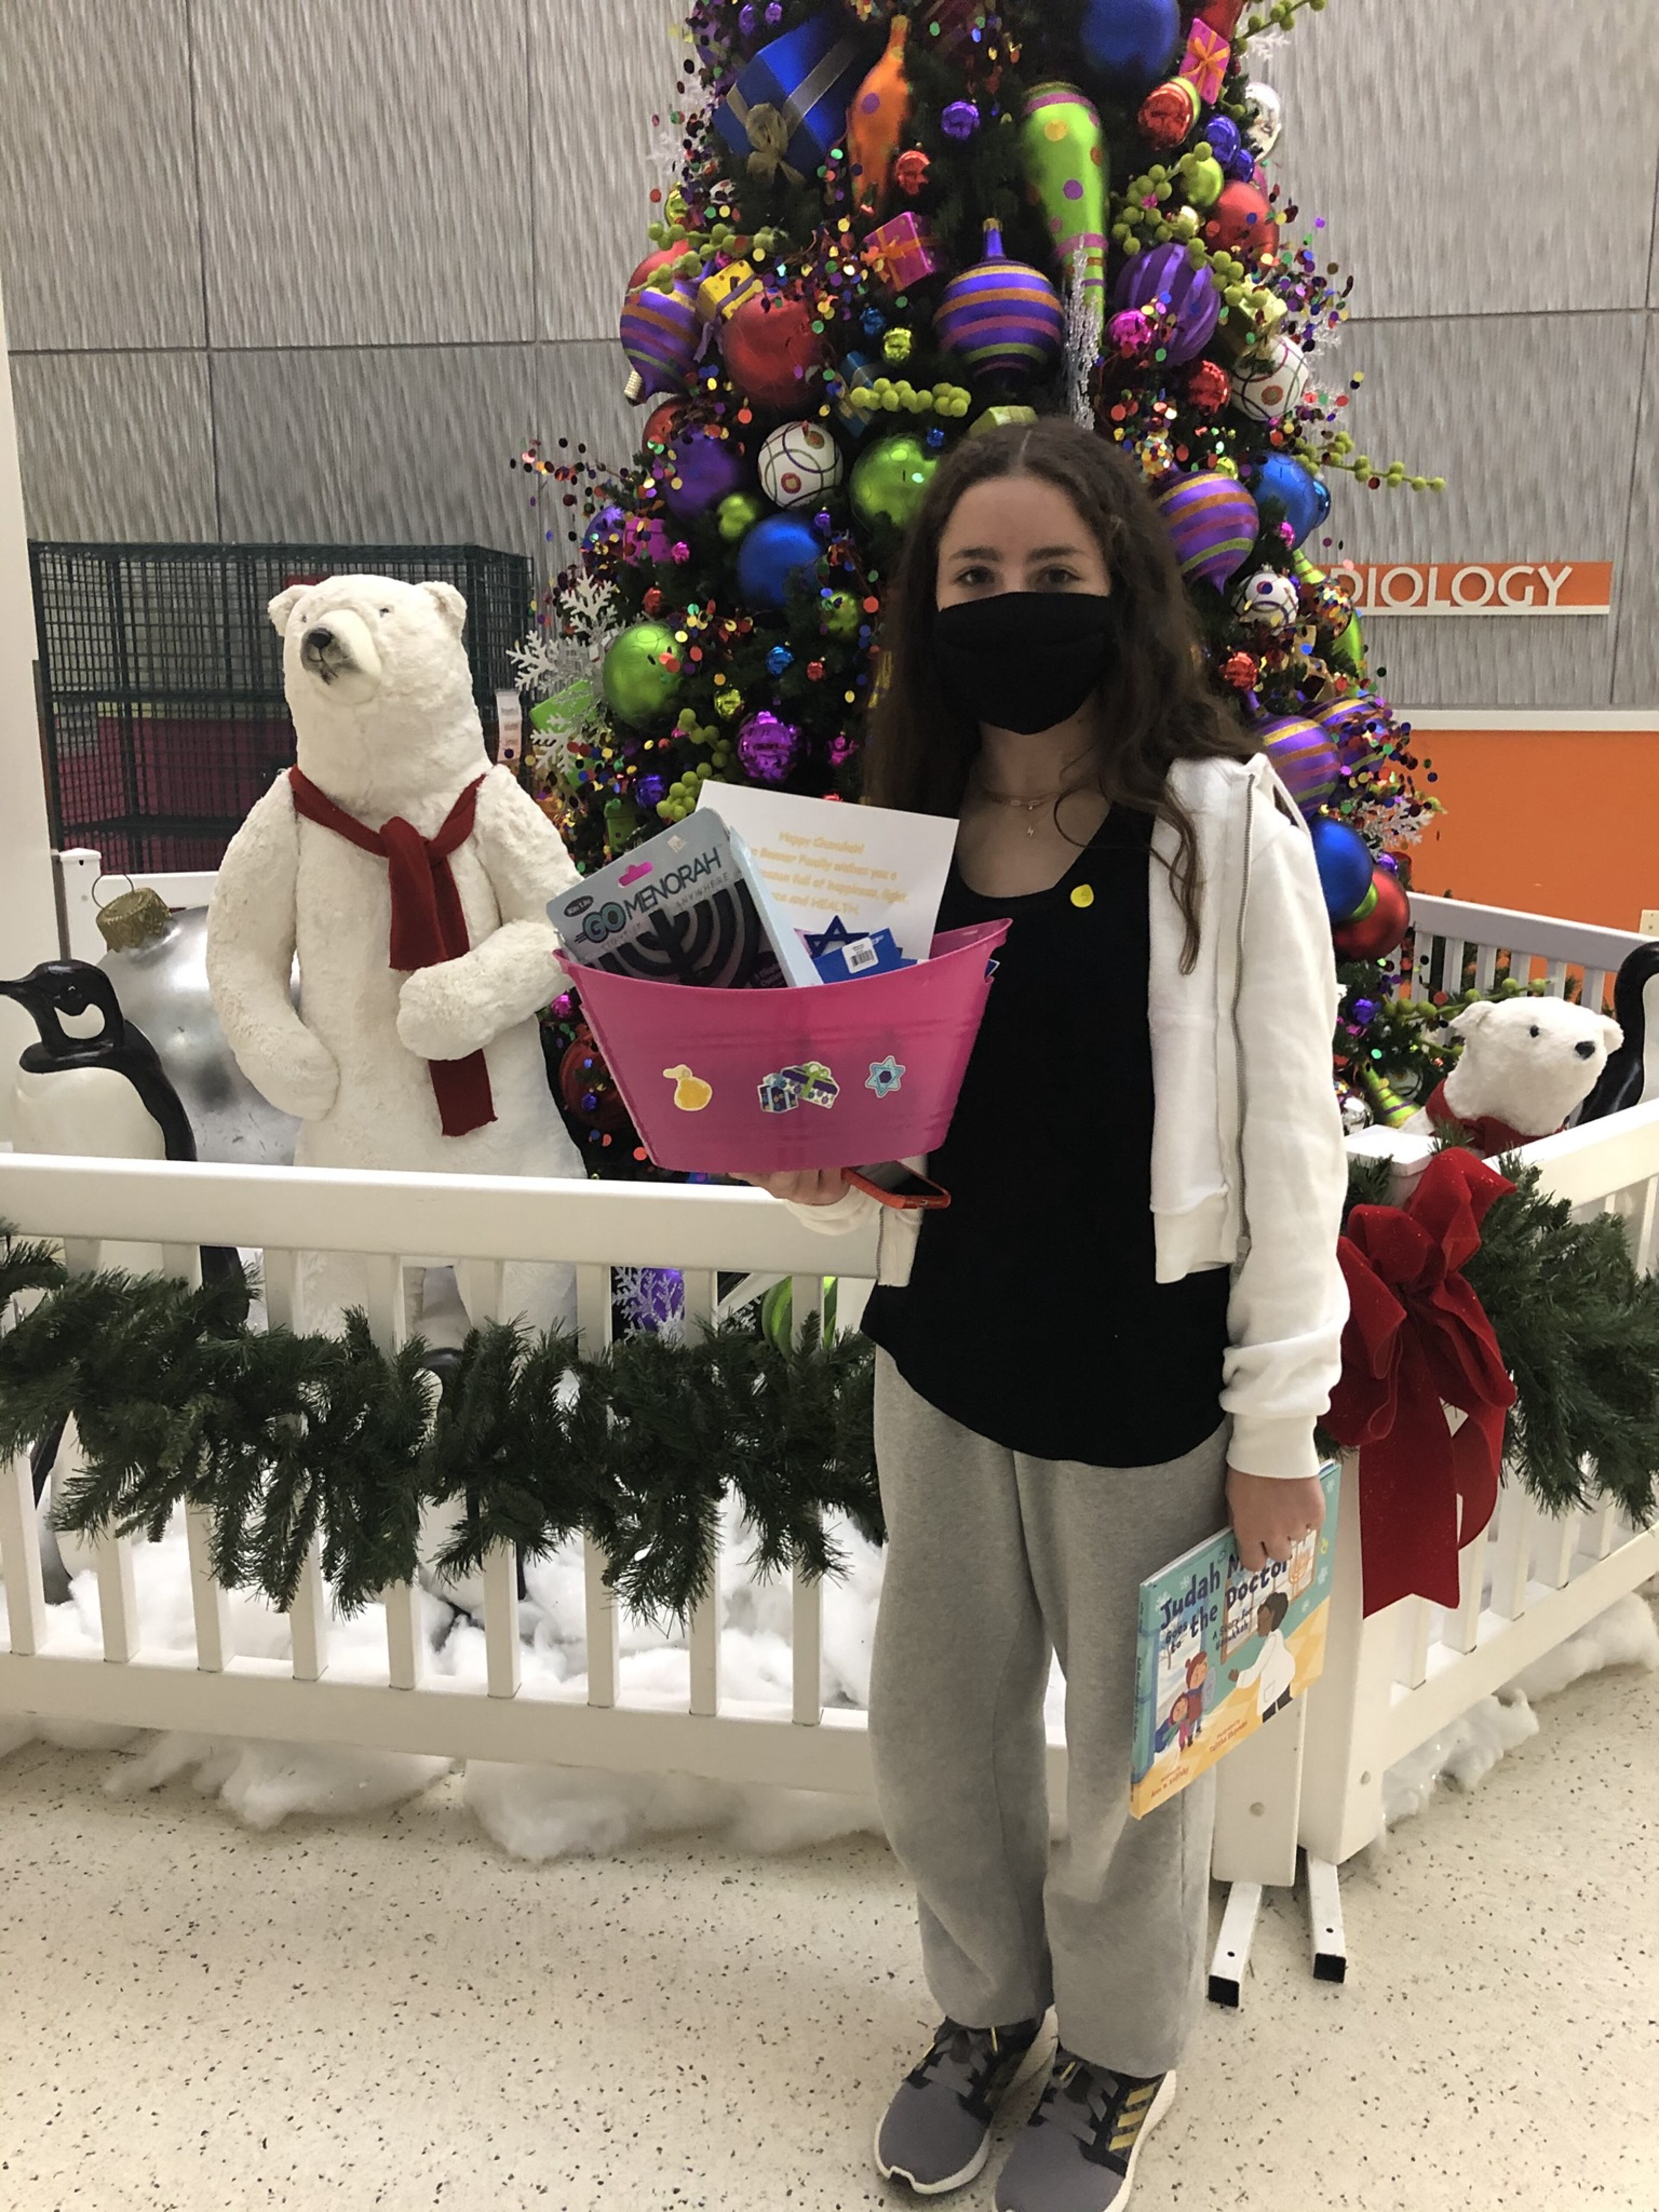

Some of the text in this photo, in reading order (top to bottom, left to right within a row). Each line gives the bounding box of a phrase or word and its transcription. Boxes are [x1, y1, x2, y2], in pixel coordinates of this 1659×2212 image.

[1330, 566, 1573, 607] DIOLOGY
[582, 847, 721, 943] GO MENORAH
[1160, 1561, 1220, 1630] Judah
[1171, 1640, 1182, 1653] to
[1191, 1605, 1217, 1637] the
